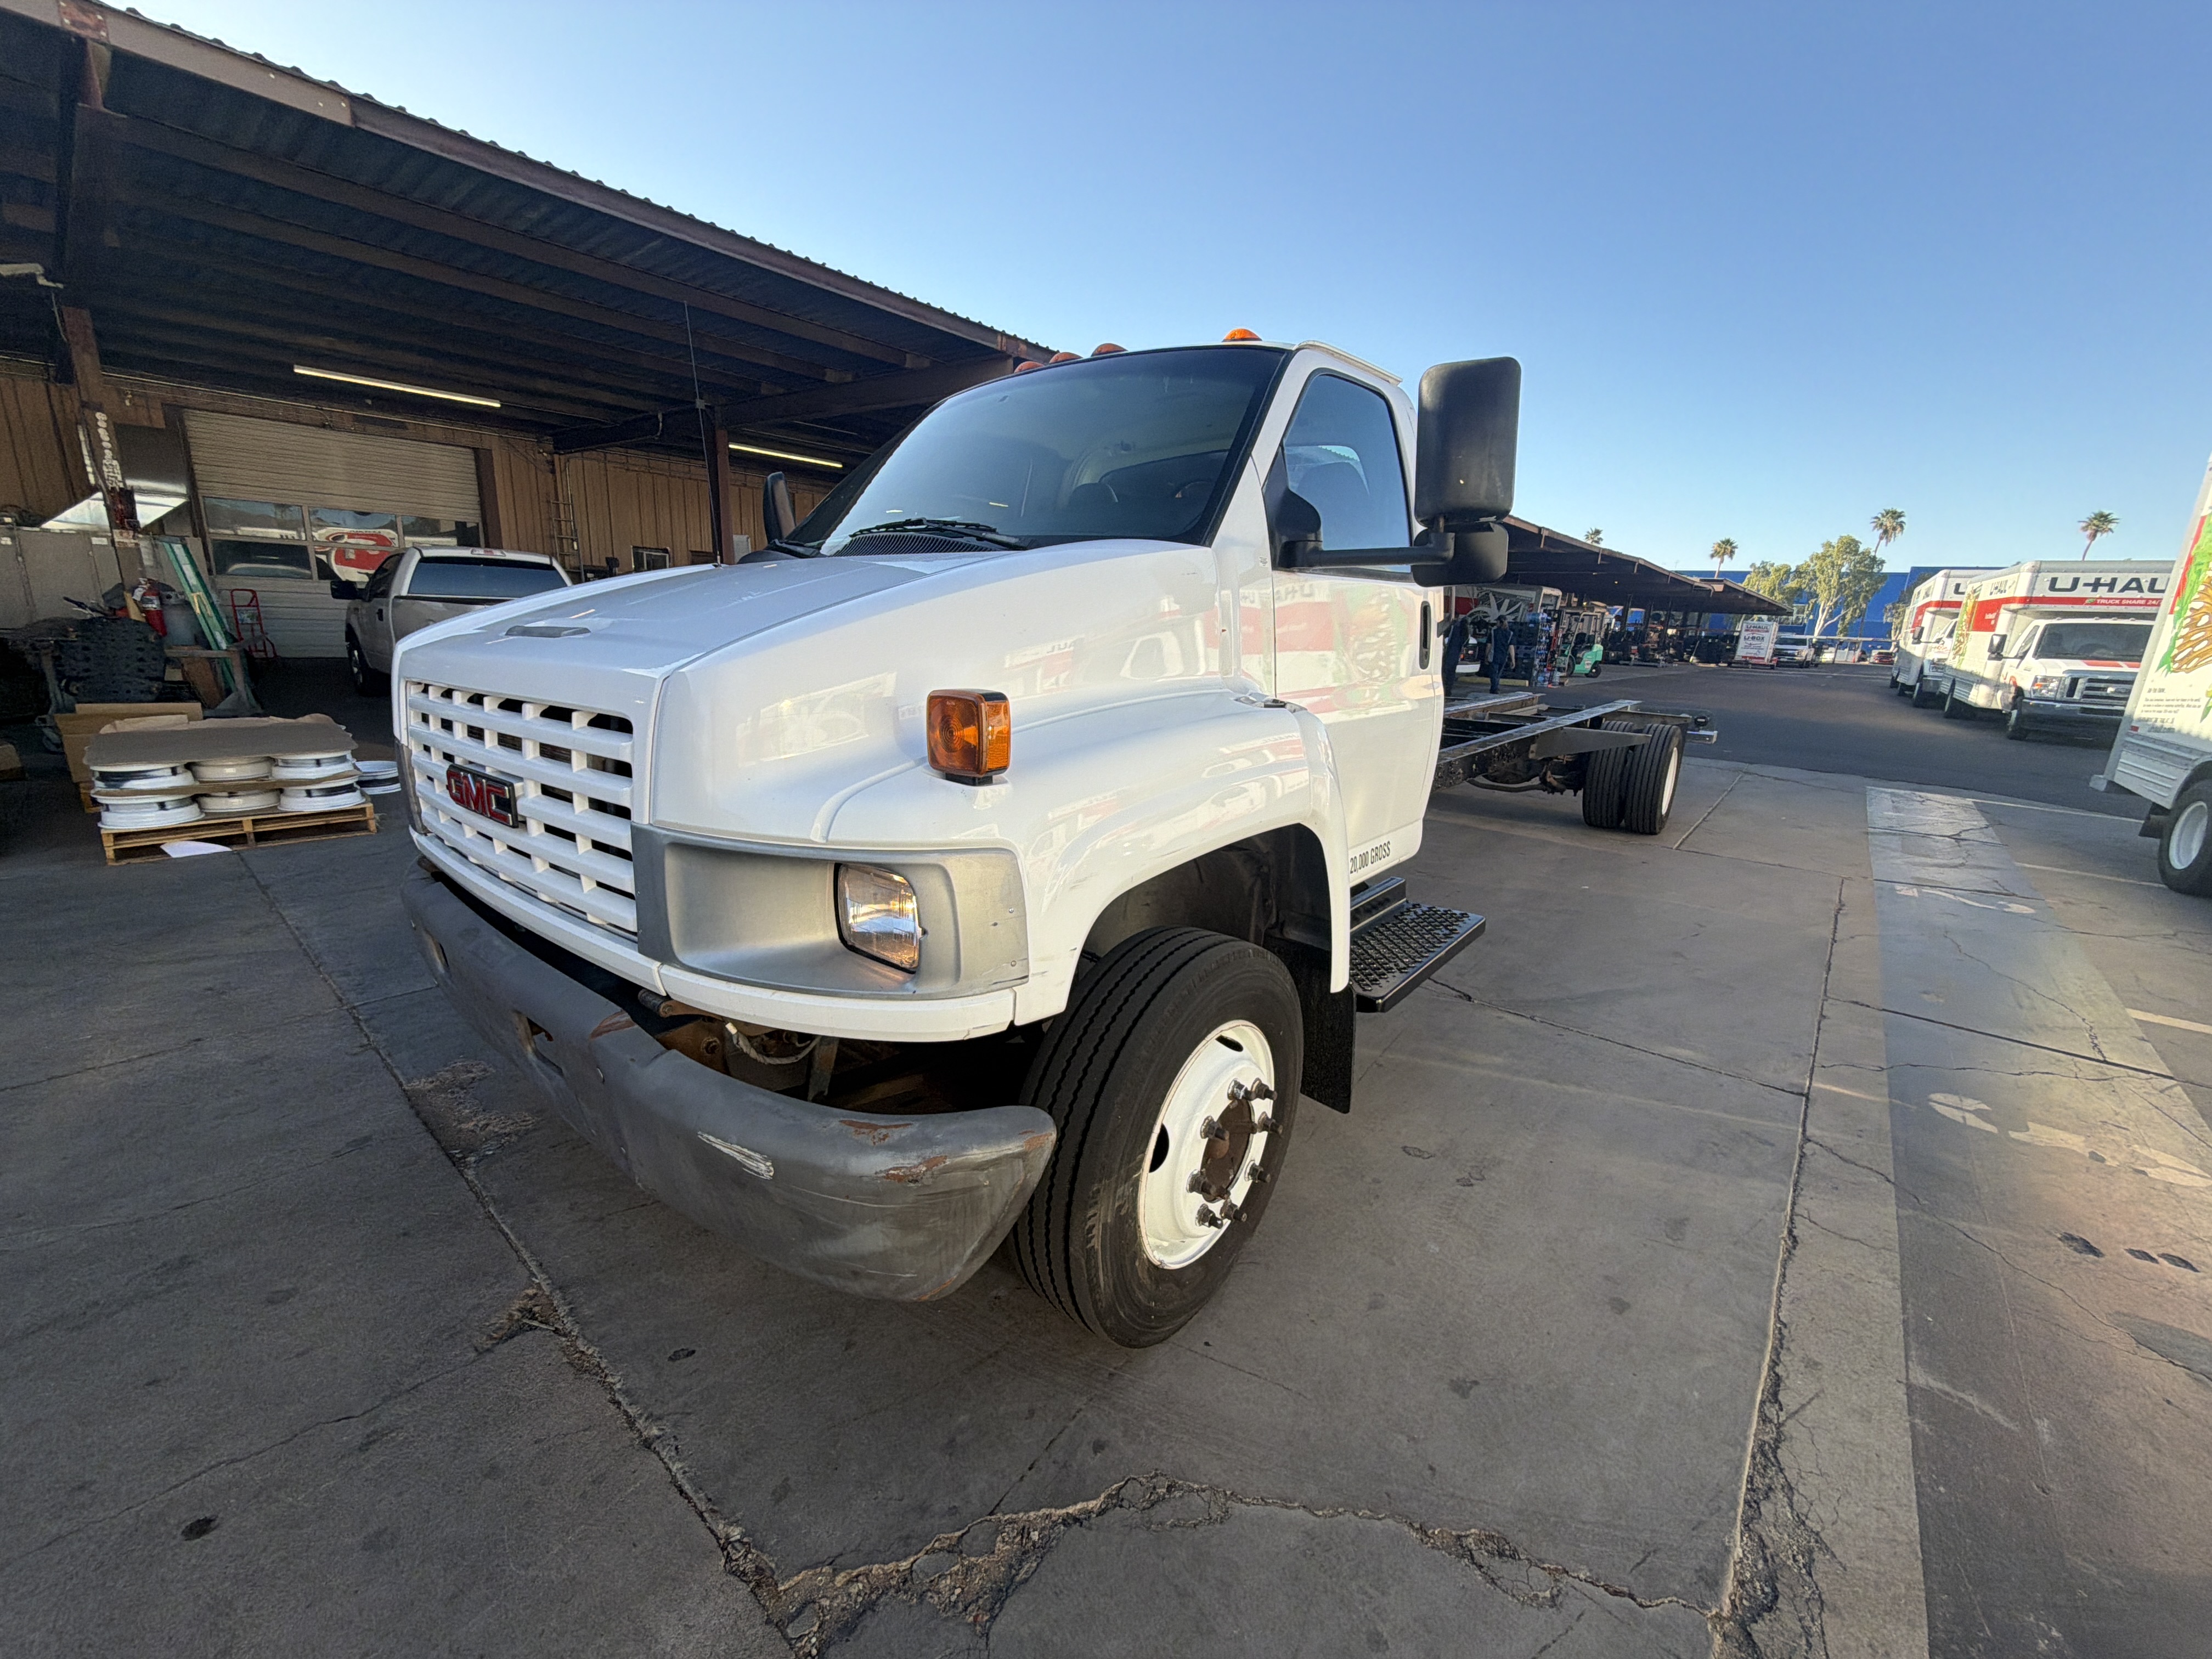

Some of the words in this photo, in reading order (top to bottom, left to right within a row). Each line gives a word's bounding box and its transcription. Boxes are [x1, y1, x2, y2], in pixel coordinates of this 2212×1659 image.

[2048, 577, 2170, 594] U-HAU
[447, 770, 513, 826] GMC
[1350, 850, 1369, 874] 20,000
[1370, 840, 1391, 865] GROSS
